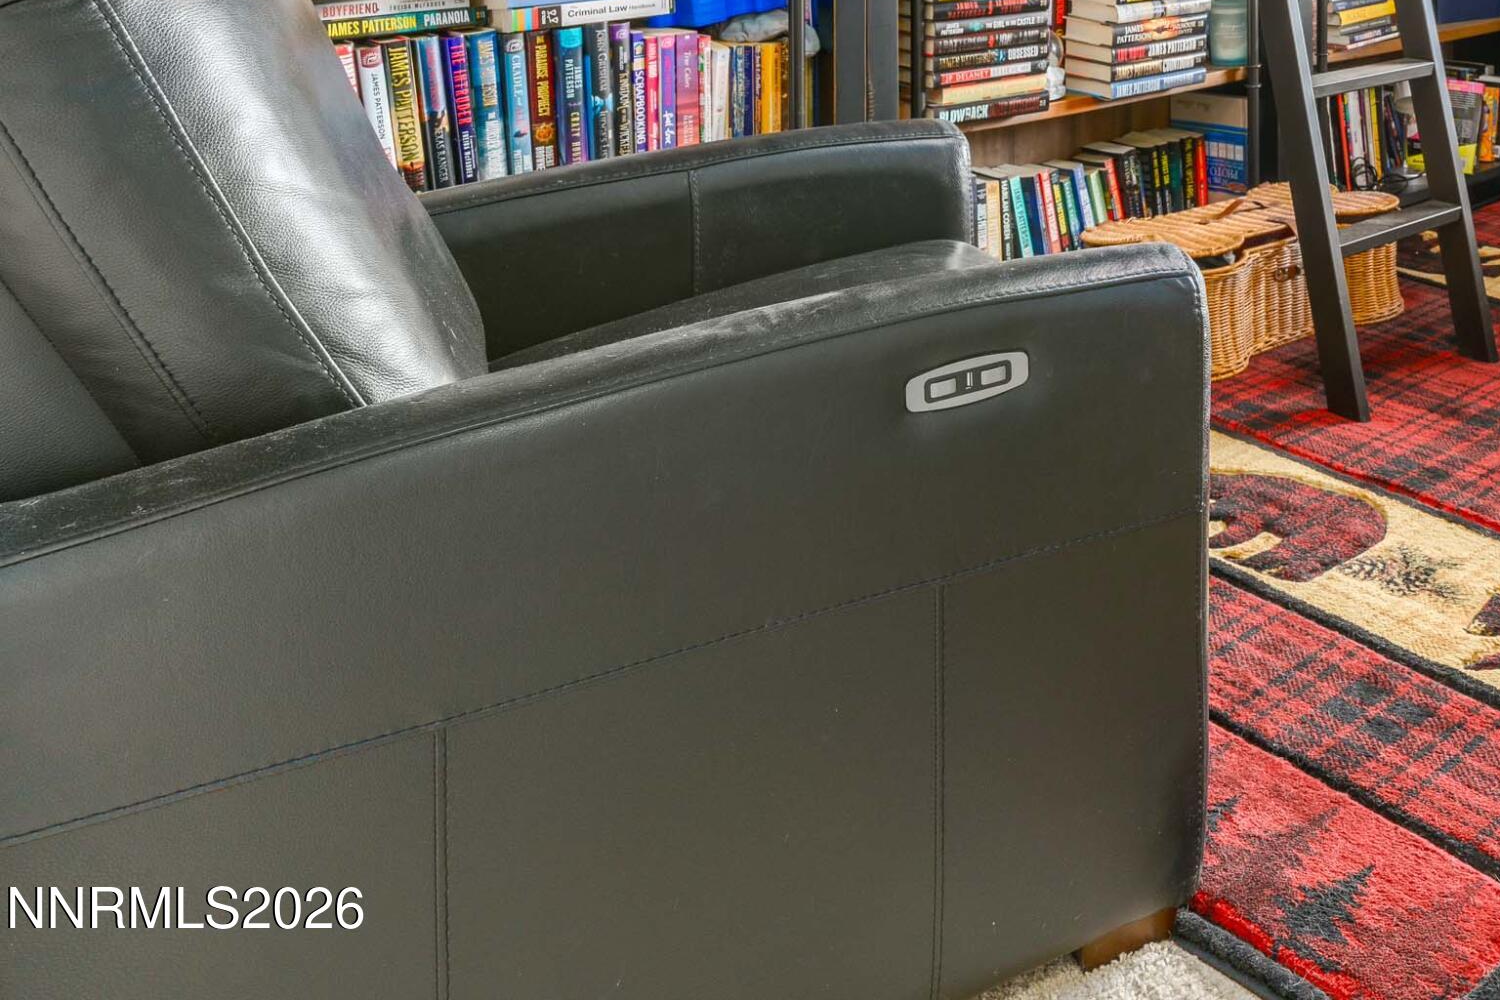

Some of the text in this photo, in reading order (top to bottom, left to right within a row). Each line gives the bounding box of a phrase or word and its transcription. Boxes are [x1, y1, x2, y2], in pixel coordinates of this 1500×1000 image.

[322, 2, 378, 18] BOYFRIEND
[568, 3, 628, 18] Criminal Law
[328, 10, 470, 37] JAMES PATTERSON PARANOIA
[993, 17, 1036, 29] GIRL CASTLE
[1124, 24, 1144, 34] JAMES
[1117, 32, 1152, 44] PATTERSON
[1008, 46, 1038, 60] OBSESSED
[450, 44, 472, 126] THE INTRUDER
[564, 58, 574, 99] PATTERSON
[574, 66, 583, 89] JAMES
[371, 73, 386, 140] JAMES PATTERSON
[389, 48, 421, 163] JAMES PATTERSON
[634, 70, 646, 145] SCRAPBOOKING
[940, 104, 989, 122] BLOWBACK
[1002, 180, 1011, 240] HARLAN COBEN
